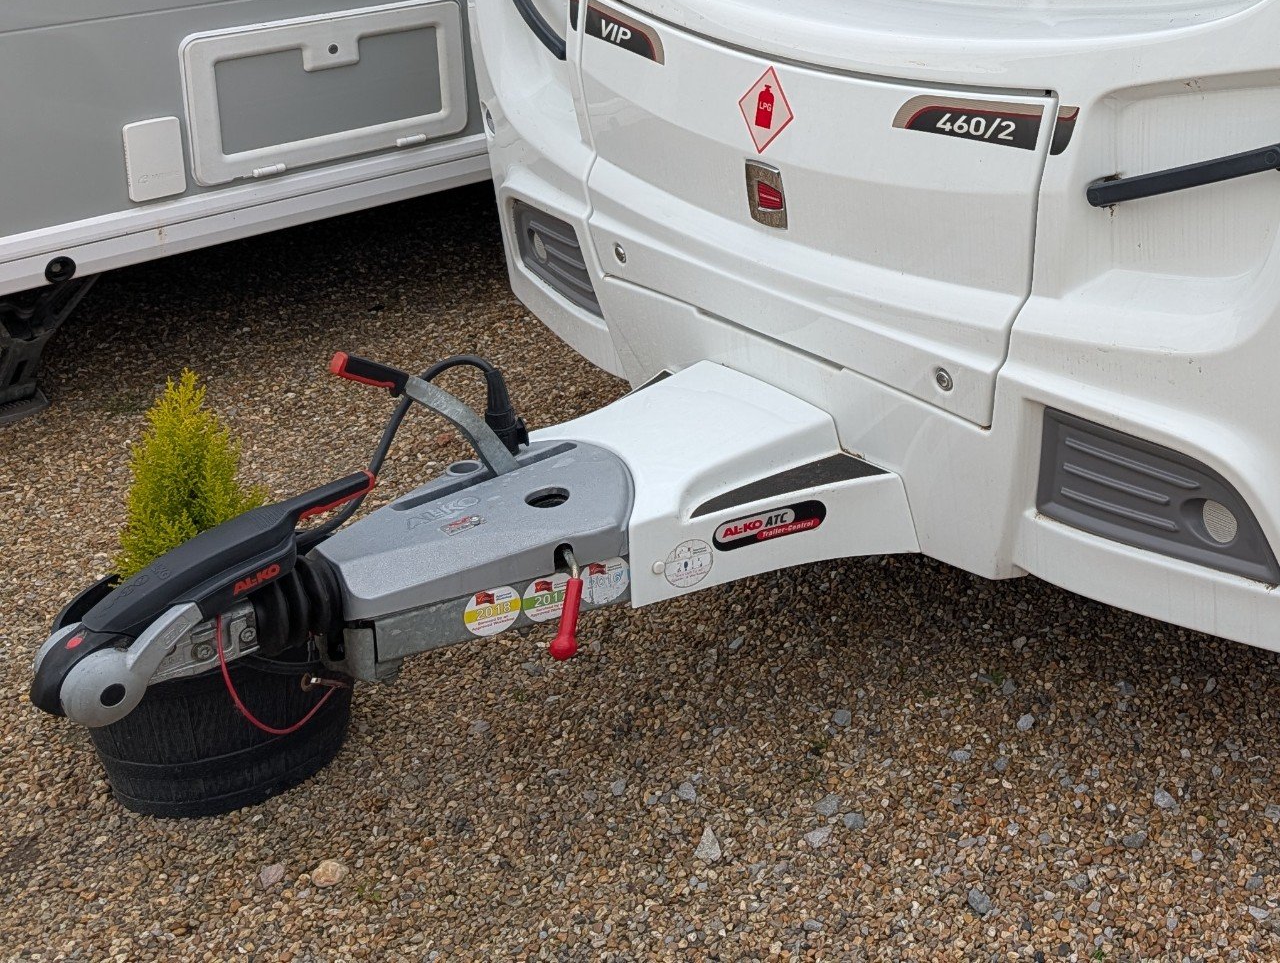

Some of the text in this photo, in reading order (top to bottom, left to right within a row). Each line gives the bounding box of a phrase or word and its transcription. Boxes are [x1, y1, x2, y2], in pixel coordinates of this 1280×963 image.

[601, 18, 631, 44] VIP
[759, 101, 772, 112] LPG
[936, 113, 1016, 141] 460/2
[722, 511, 789, 539] AL-KO ATC
[762, 520, 814, 538] Trailer-Control
[233, 564, 281, 596] AL-KO
[477, 602, 511, 620] 2018
